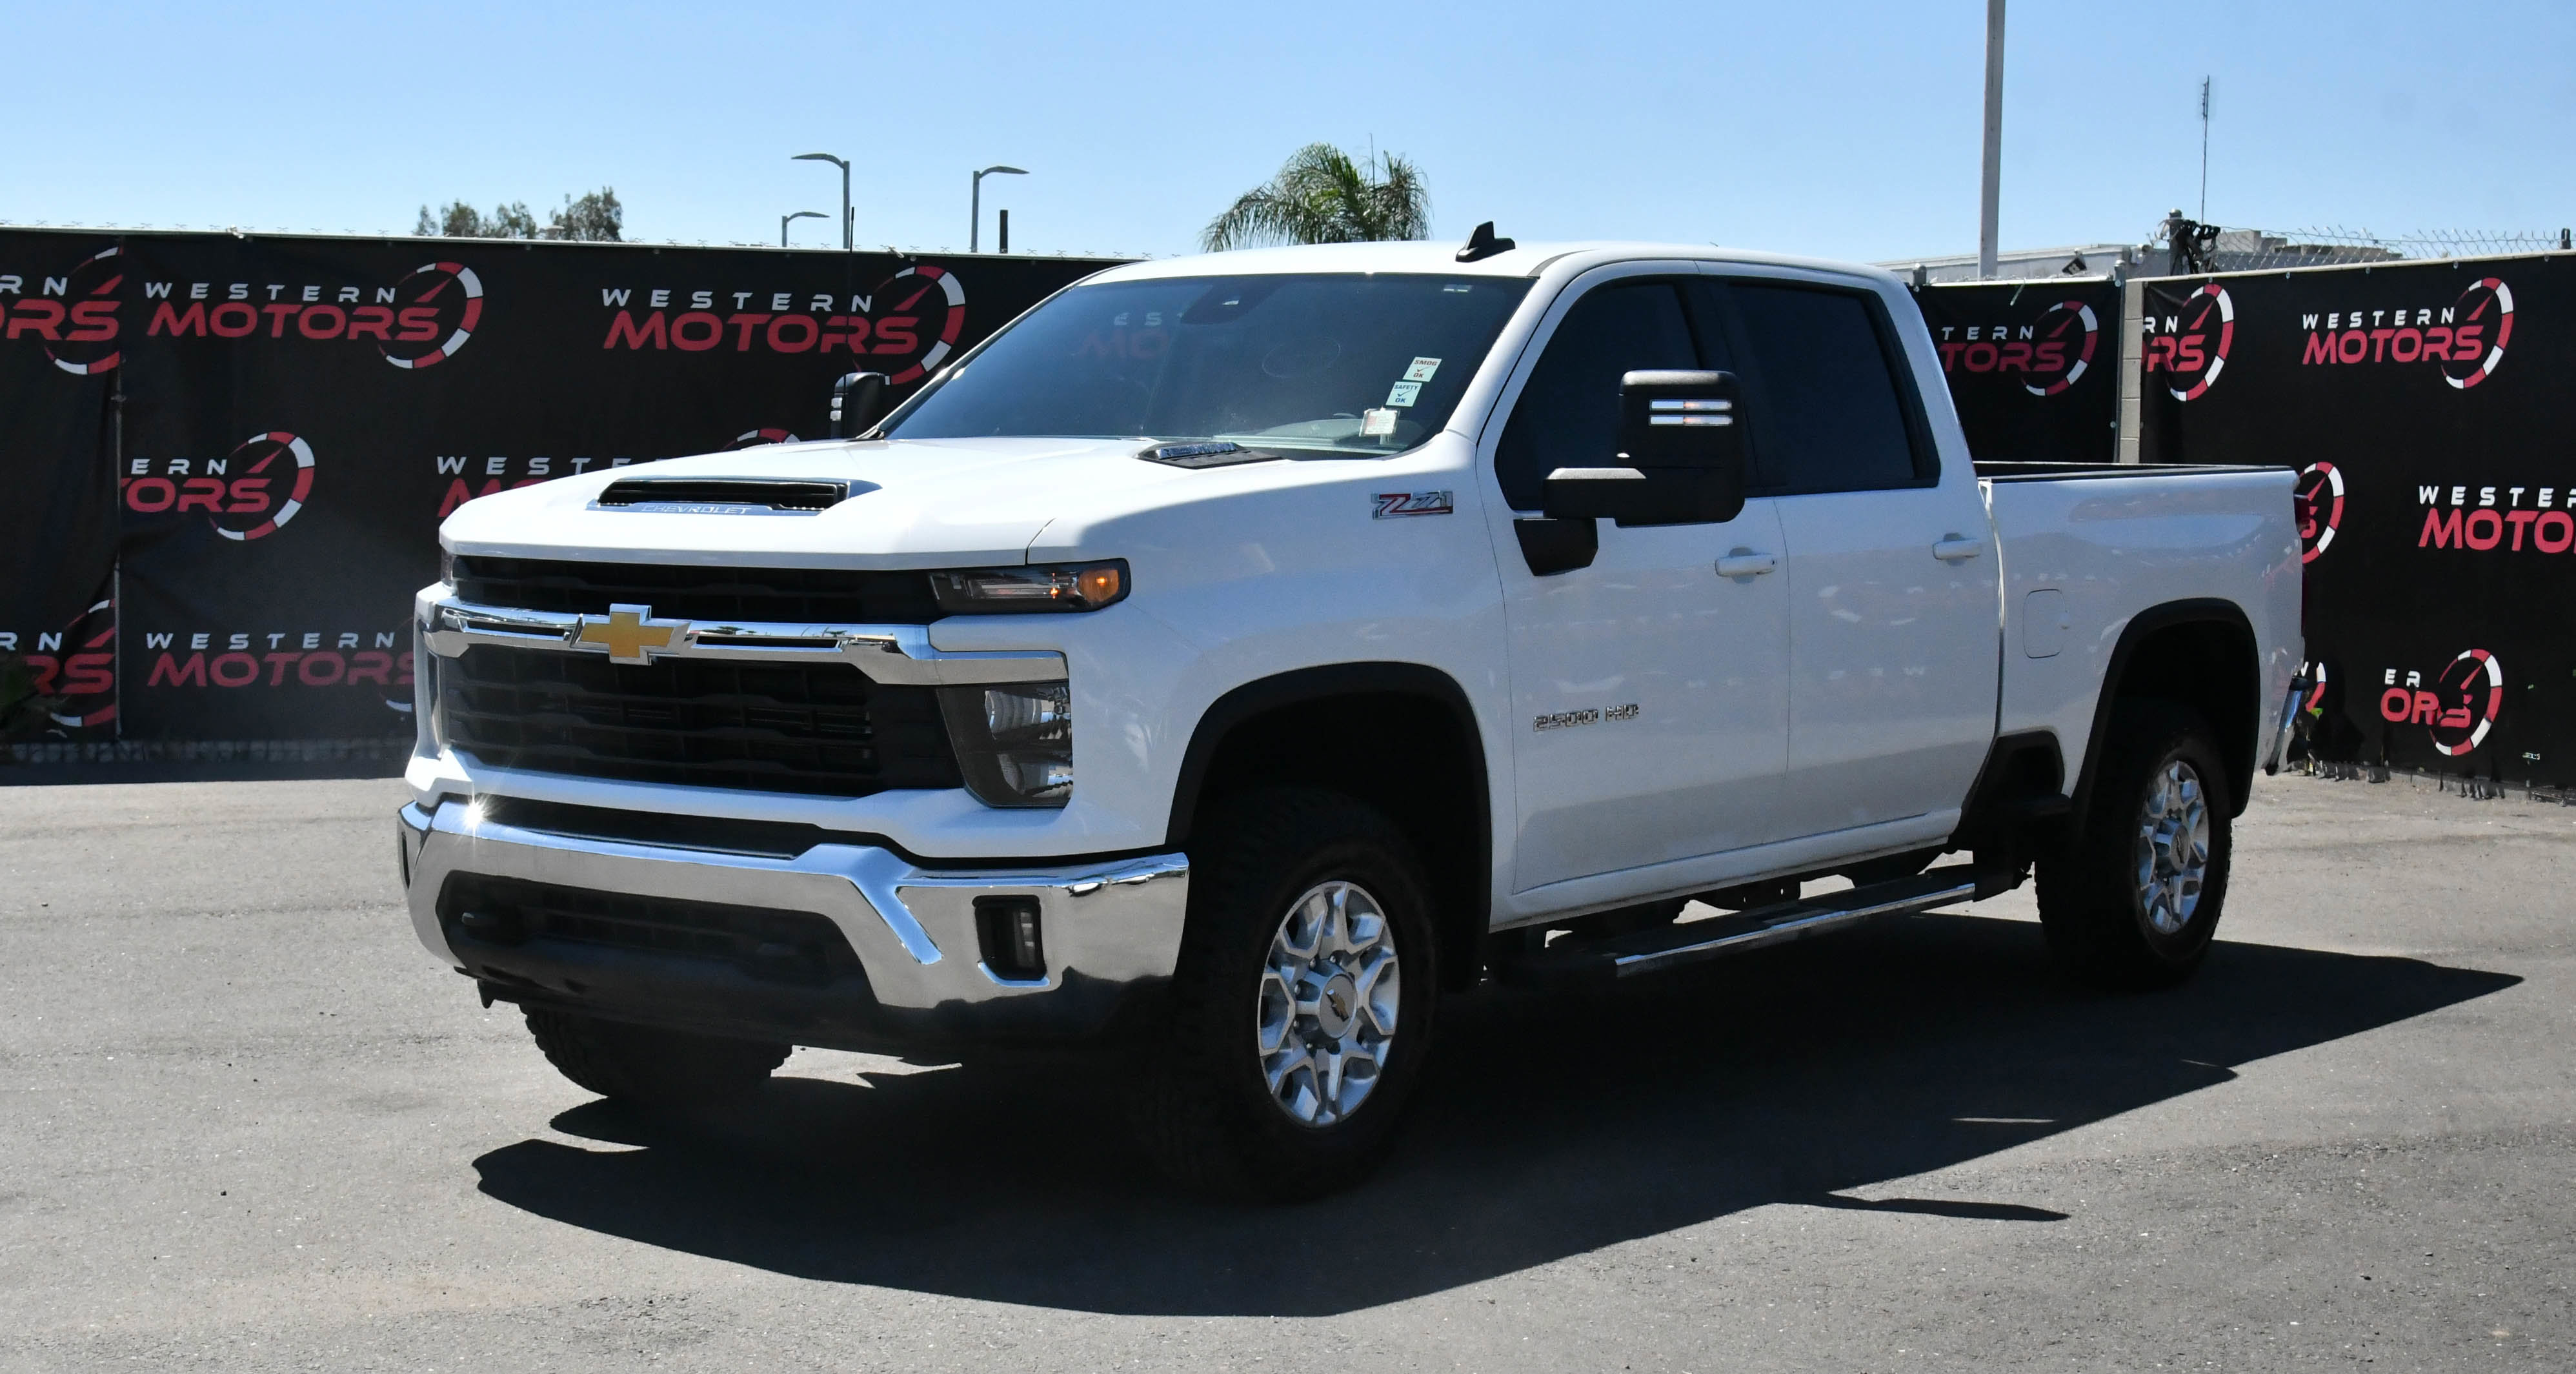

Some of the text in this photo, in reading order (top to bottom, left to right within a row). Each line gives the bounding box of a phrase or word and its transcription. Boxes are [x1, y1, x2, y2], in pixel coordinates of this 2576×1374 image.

[145, 282, 396, 303] WESTERN
[602, 288, 872, 312] WESTERN
[148, 301, 439, 341] MOTORS
[2302, 307, 2455, 330] WESTERN
[603, 310, 920, 354] MOTORS
[2302, 325, 2484, 365] MOTORS
[641, 504, 752, 514] CHEVROLET
[146, 632, 395, 649] WESTERN
[1533, 709, 1599, 732] 2500
